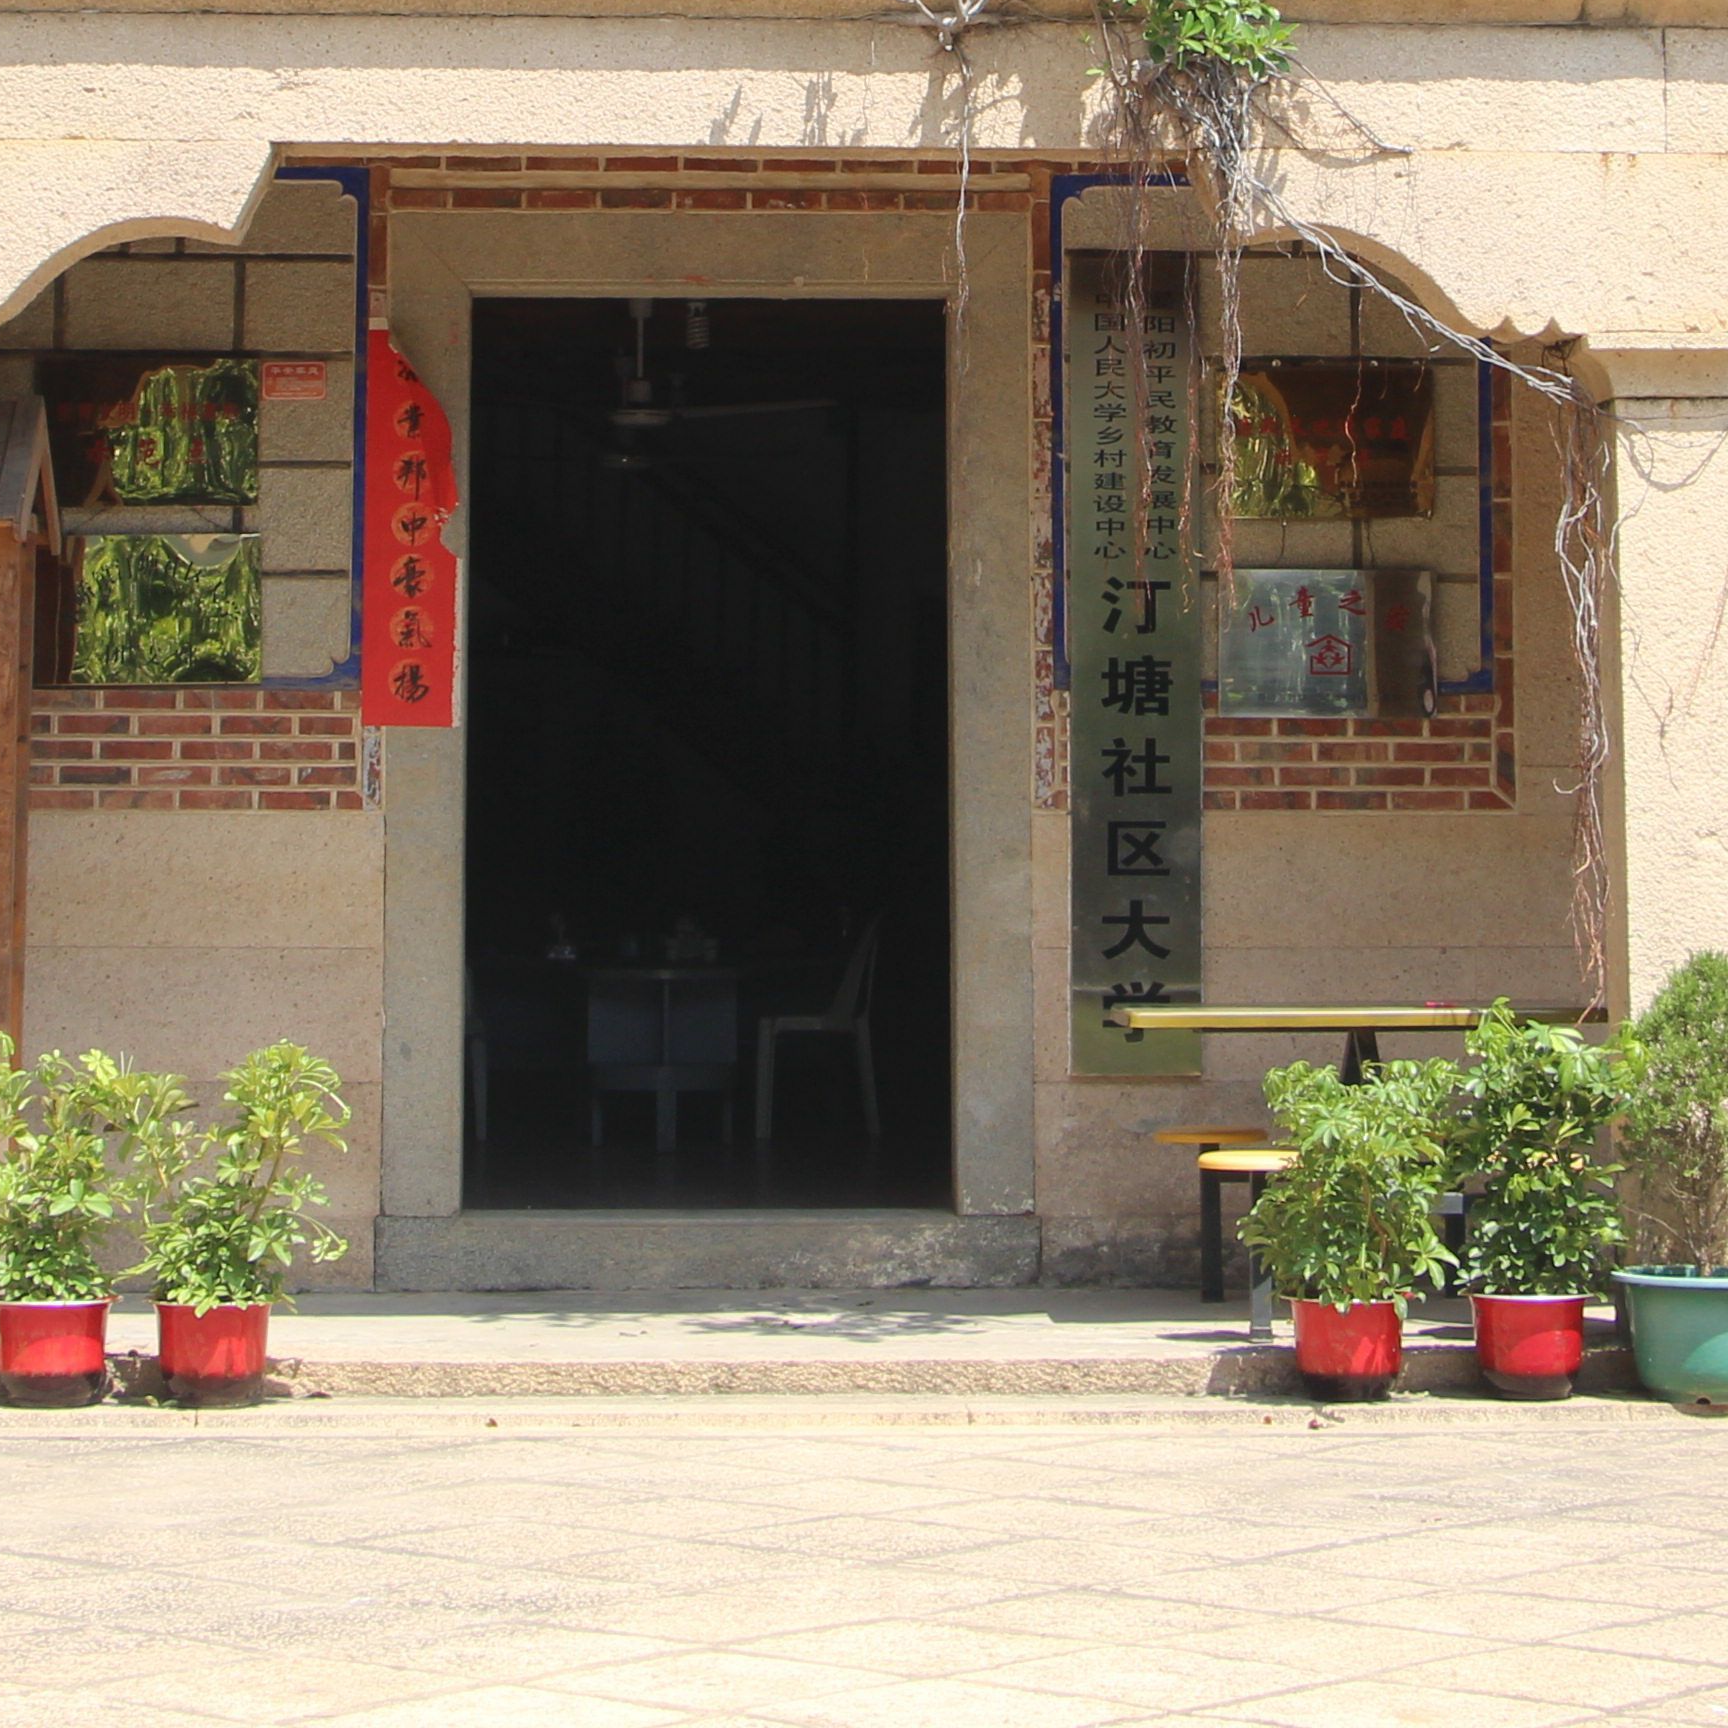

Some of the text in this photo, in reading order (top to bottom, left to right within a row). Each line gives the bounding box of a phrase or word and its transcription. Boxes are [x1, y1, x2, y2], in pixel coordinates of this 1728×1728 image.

[1093, 292, 1128, 560] 中国人民大学乡村建设中心
[1142, 289, 1177, 560] 阳初平民教育发展中心
[1100, 576, 1174, 1044] 汀塘社区大学
